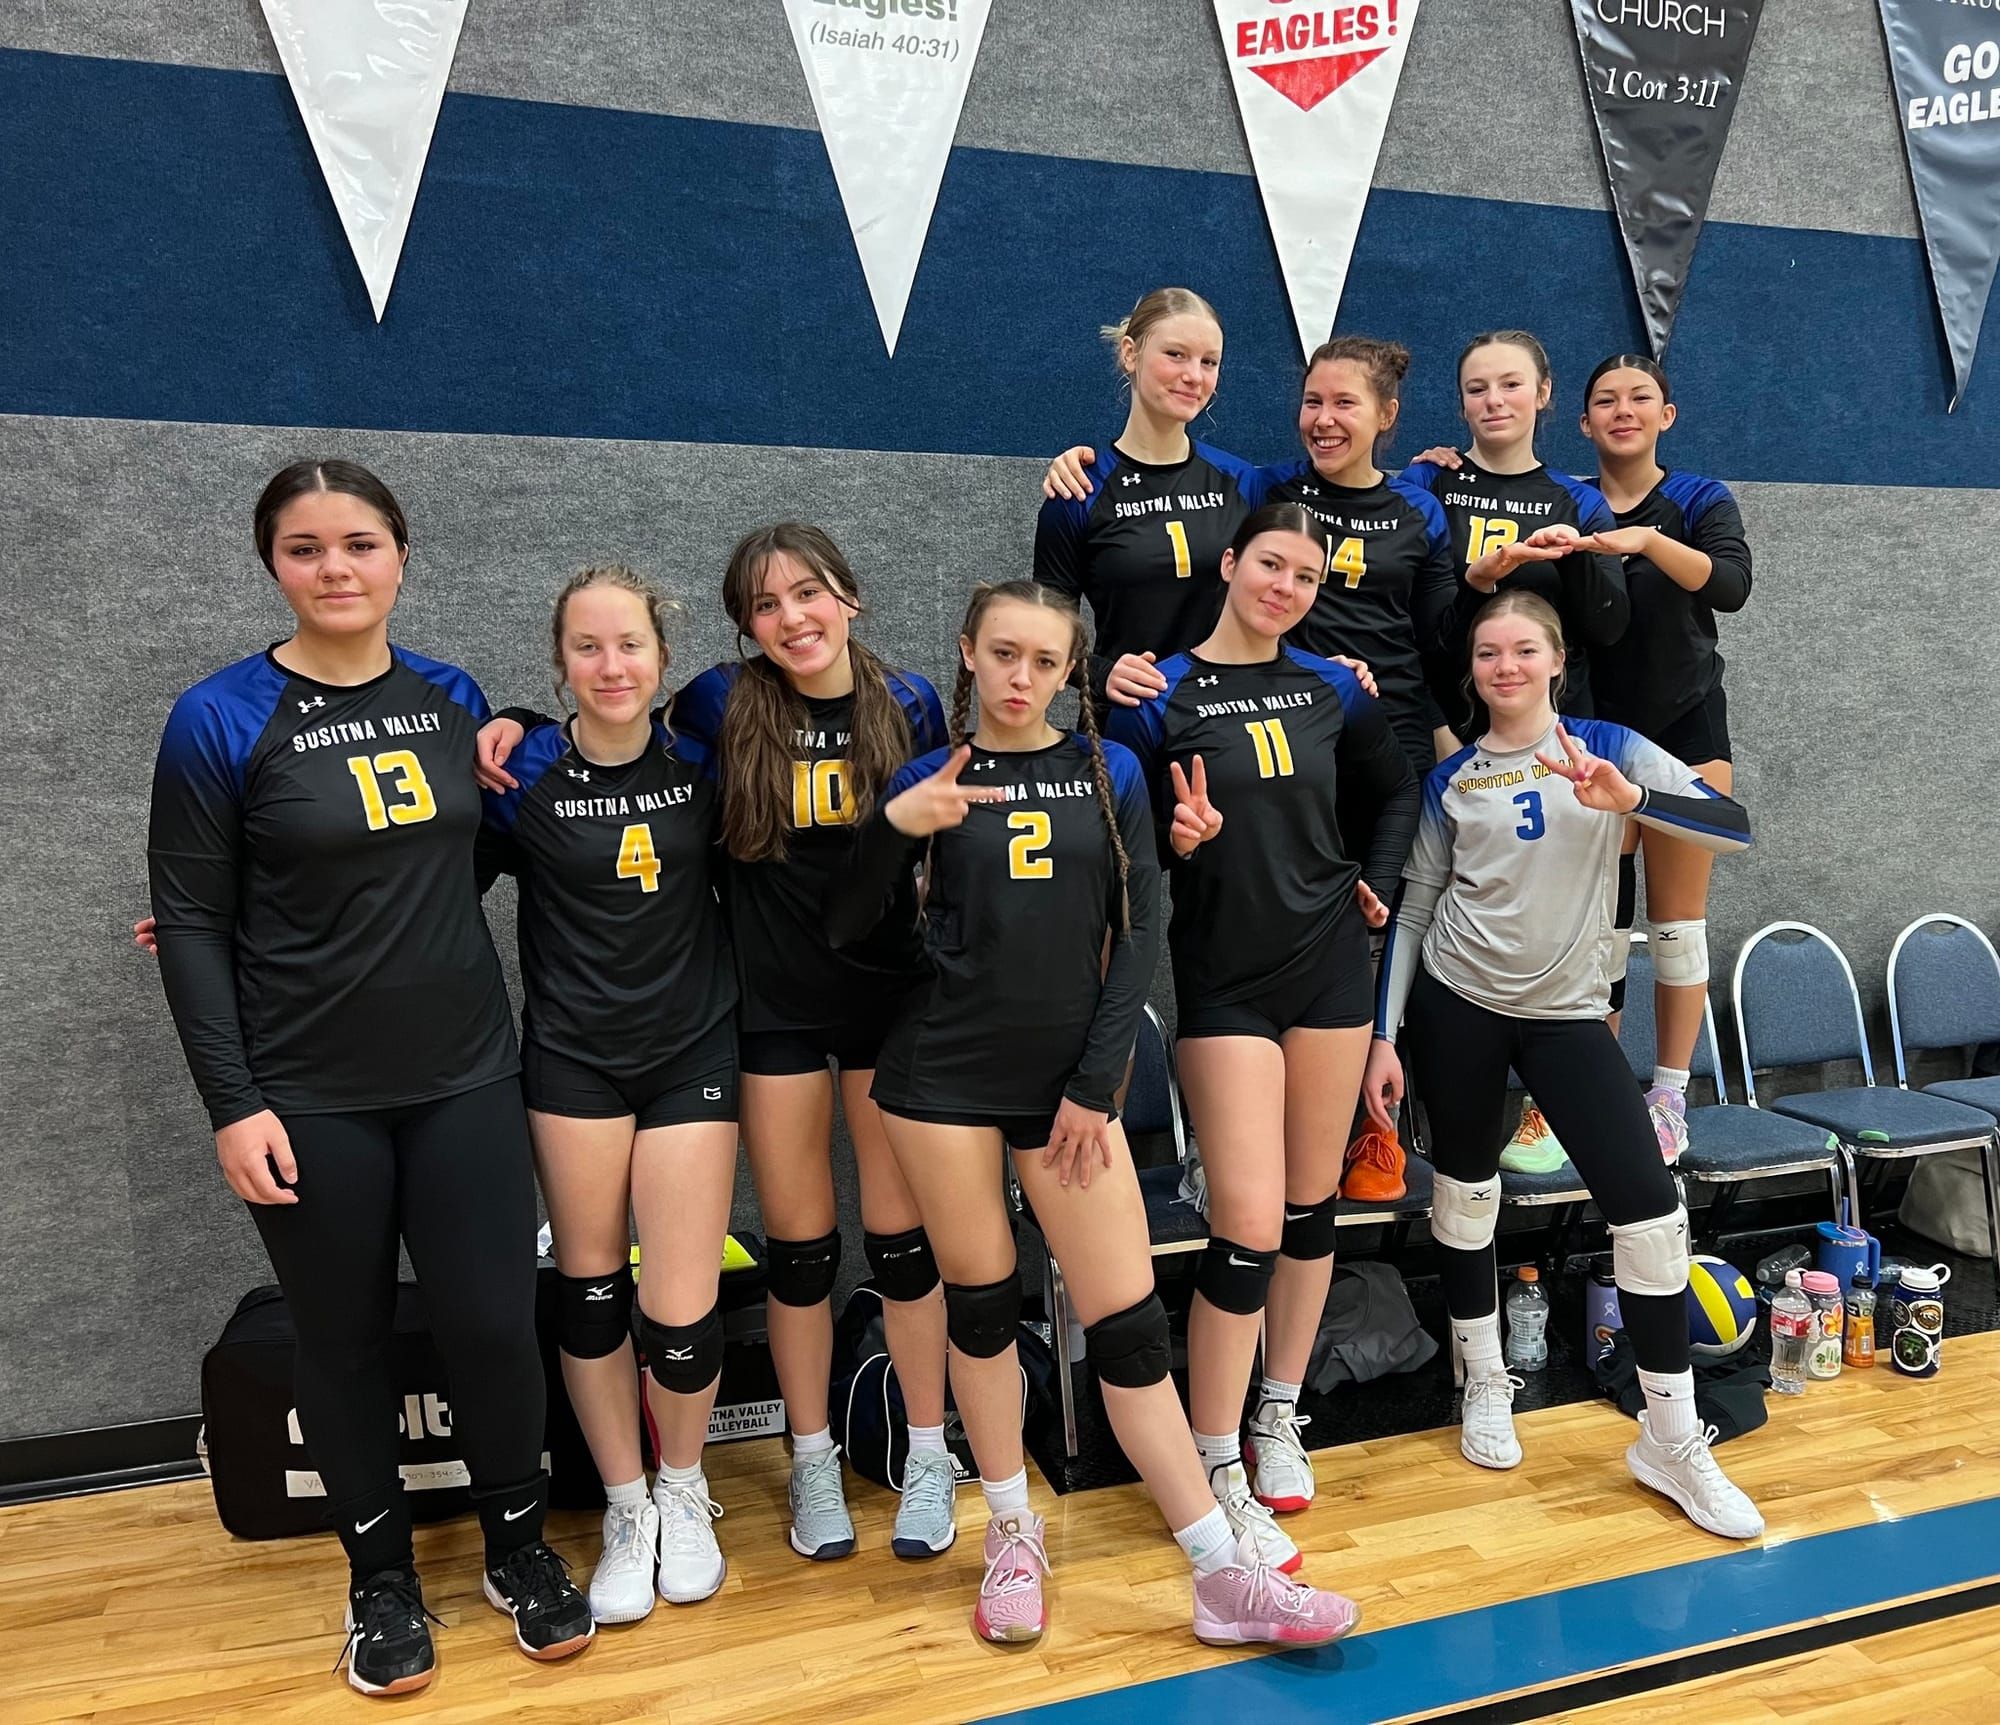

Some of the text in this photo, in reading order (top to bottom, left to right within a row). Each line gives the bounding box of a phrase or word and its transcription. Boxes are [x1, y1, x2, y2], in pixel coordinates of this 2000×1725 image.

[1236, 0, 1398, 57] EAGLES!
[1597, 0, 1726, 38] CHURCH
[810, 21, 959, 62] (Isaiah 40:31)
[1943, 41, 2000, 84] GO
[1604, 68, 1721, 108] 1 Cor 3:11
[1115, 492, 1224, 518] SUSITNA VALLEY
[1445, 492, 1552, 516] SUSITNA VALLEY
[1350, 518, 1398, 531] VALLEY
[1466, 515, 1519, 565] 12
[1166, 521, 1191, 578] 1
[1196, 691, 1313, 719] SUSITNA VALLEY
[293, 712, 441, 752] SUSITNA VALLEY
[1244, 718, 1295, 779] 11
[347, 749, 437, 831] 13
[554, 783, 693, 818] SUSITNA VALLEY
[792, 759, 859, 829] 10
[1036, 780, 1092, 799] VALLEY
[1457, 769, 1525, 794] SUSITNA
[1512, 790, 1546, 841] 3
[616, 823, 661, 893] 4
[1007, 811, 1053, 879] 2
[708, 1417, 770, 1434] OLLEYBALL
[739, 1403, 780, 1417] VALLEY
